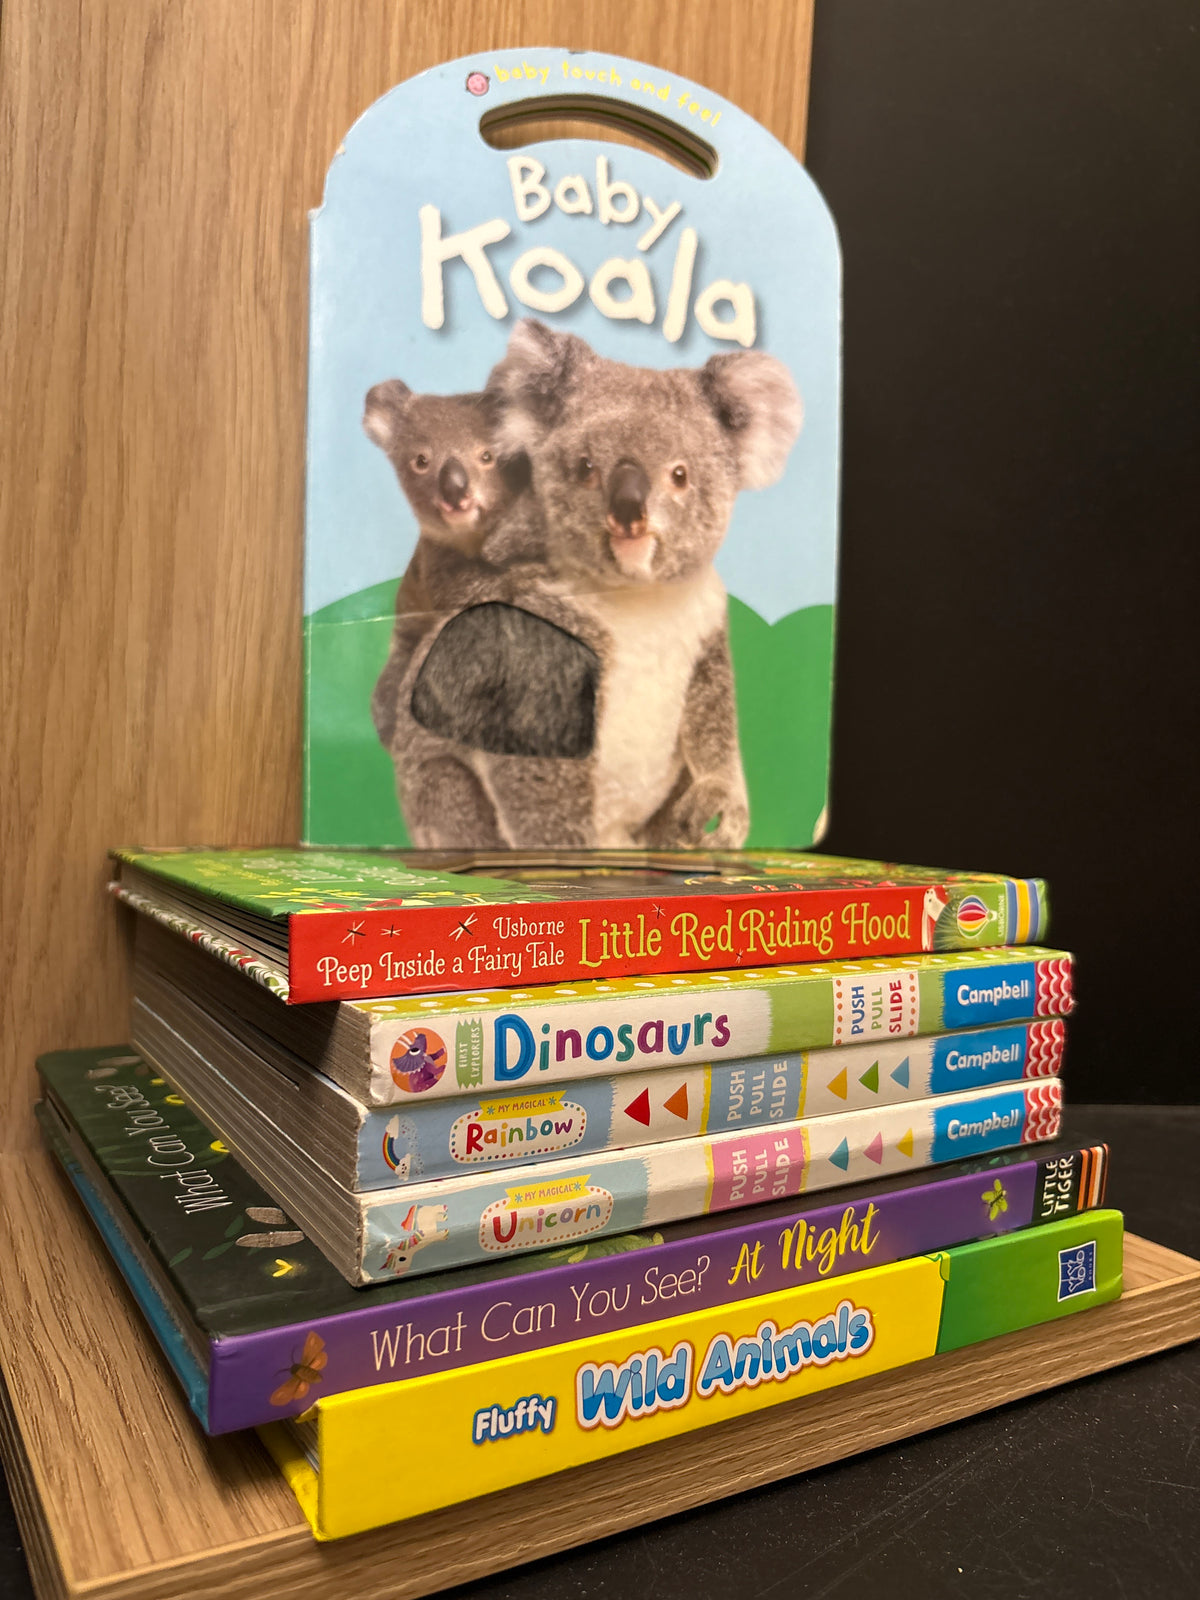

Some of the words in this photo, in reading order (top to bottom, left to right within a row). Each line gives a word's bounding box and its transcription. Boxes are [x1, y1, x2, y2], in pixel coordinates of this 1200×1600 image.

[494, 61, 550, 84] baby
[562, 60, 622, 86] touch
[630, 78, 671, 102] and
[677, 92, 722, 127] feel
[507, 154, 684, 252] Baby
[418, 203, 757, 348] Koala
[493, 917, 565, 940] Usborne
[578, 913, 662, 968] Little
[671, 909, 734, 962] Red
[739, 905, 832, 955] Riding
[841, 900, 911, 945] Hood
[316, 956, 372, 990] Peep
[379, 950, 446, 981] Inside
[452, 958, 464, 974] a
[468, 947, 522, 979] Fairy
[526, 941, 565, 969] Tale
[850, 985, 865, 1036] PUSH
[870, 986, 884, 1030] PULL
[889, 979, 903, 1034] SLIDE
[957, 980, 1030, 1007] Campbell
[459, 1043, 468, 1068] FIRST
[470, 1026, 480, 1078] EXPLORERS
[493, 1011, 731, 1082] Dinosaurs
[945, 1044, 1020, 1072] Campbell
[498, 1103, 510, 1113] MY
[727, 1069, 746, 1122] PUSH
[749, 1070, 766, 1117] PULL
[769, 1059, 788, 1118] SLIDE
[124, 1109, 170, 1136] You
[466, 1117, 573, 1155] Rainbow
[946, 1109, 1020, 1141] Campbell
[147, 1134, 195, 1167] Can
[752, 1148, 768, 1195] PULL
[772, 1136, 790, 1196] SLIDE
[159, 1169, 233, 1215] What
[524, 1190, 536, 1201] MY
[729, 1149, 747, 1202] PUSH
[492, 1203, 601, 1244] Unicorn
[370, 1311, 467, 1371] What
[480, 1301, 556, 1343] Can
[569, 1281, 630, 1323] You
[640, 1256, 711, 1306] See?
[727, 1241, 765, 1286] At
[777, 1202, 881, 1276] Night
[577, 1342, 693, 1428] Wild
[699, 1302, 873, 1396] Animals
[474, 1395, 556, 1443] Fluffy
